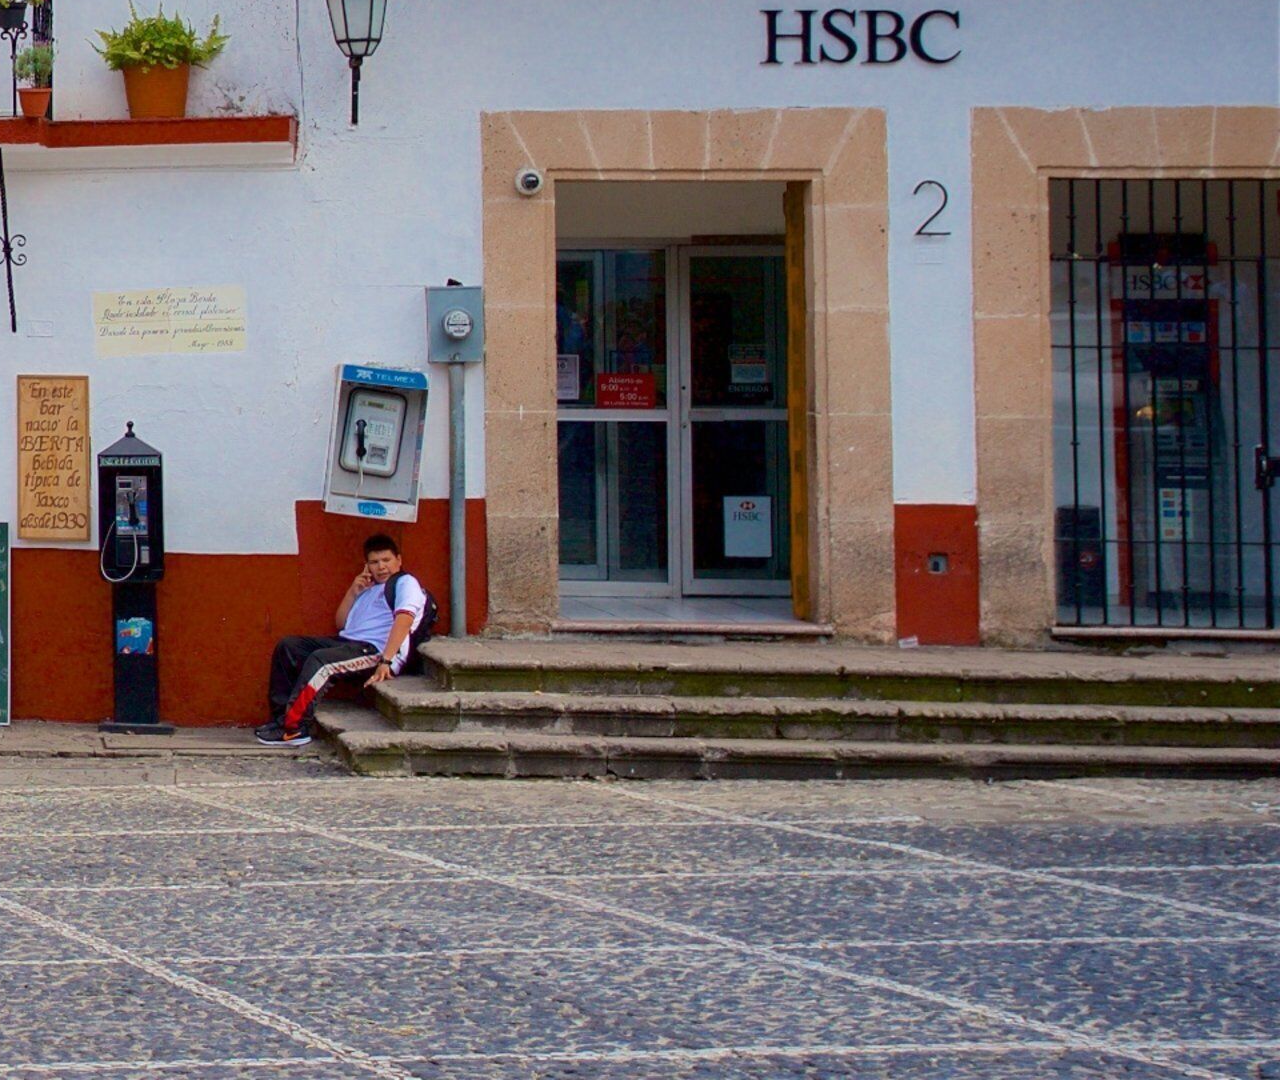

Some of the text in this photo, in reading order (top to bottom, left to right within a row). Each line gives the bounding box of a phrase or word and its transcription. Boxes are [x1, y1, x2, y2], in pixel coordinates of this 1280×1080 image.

[759, 8, 962, 65] HSBC
[913, 179, 952, 237] 2
[375, 373, 417, 384] TELMEX
[29, 382, 74, 399] En este
[39, 399, 65, 416] bar
[65, 416, 79, 431] la
[20, 435, 85, 453] BERTA
[32, 454, 74, 471] bebida
[66, 470, 82, 487] de
[33, 491, 70, 509] Taxco
[20, 511, 88, 531] desde 1930
